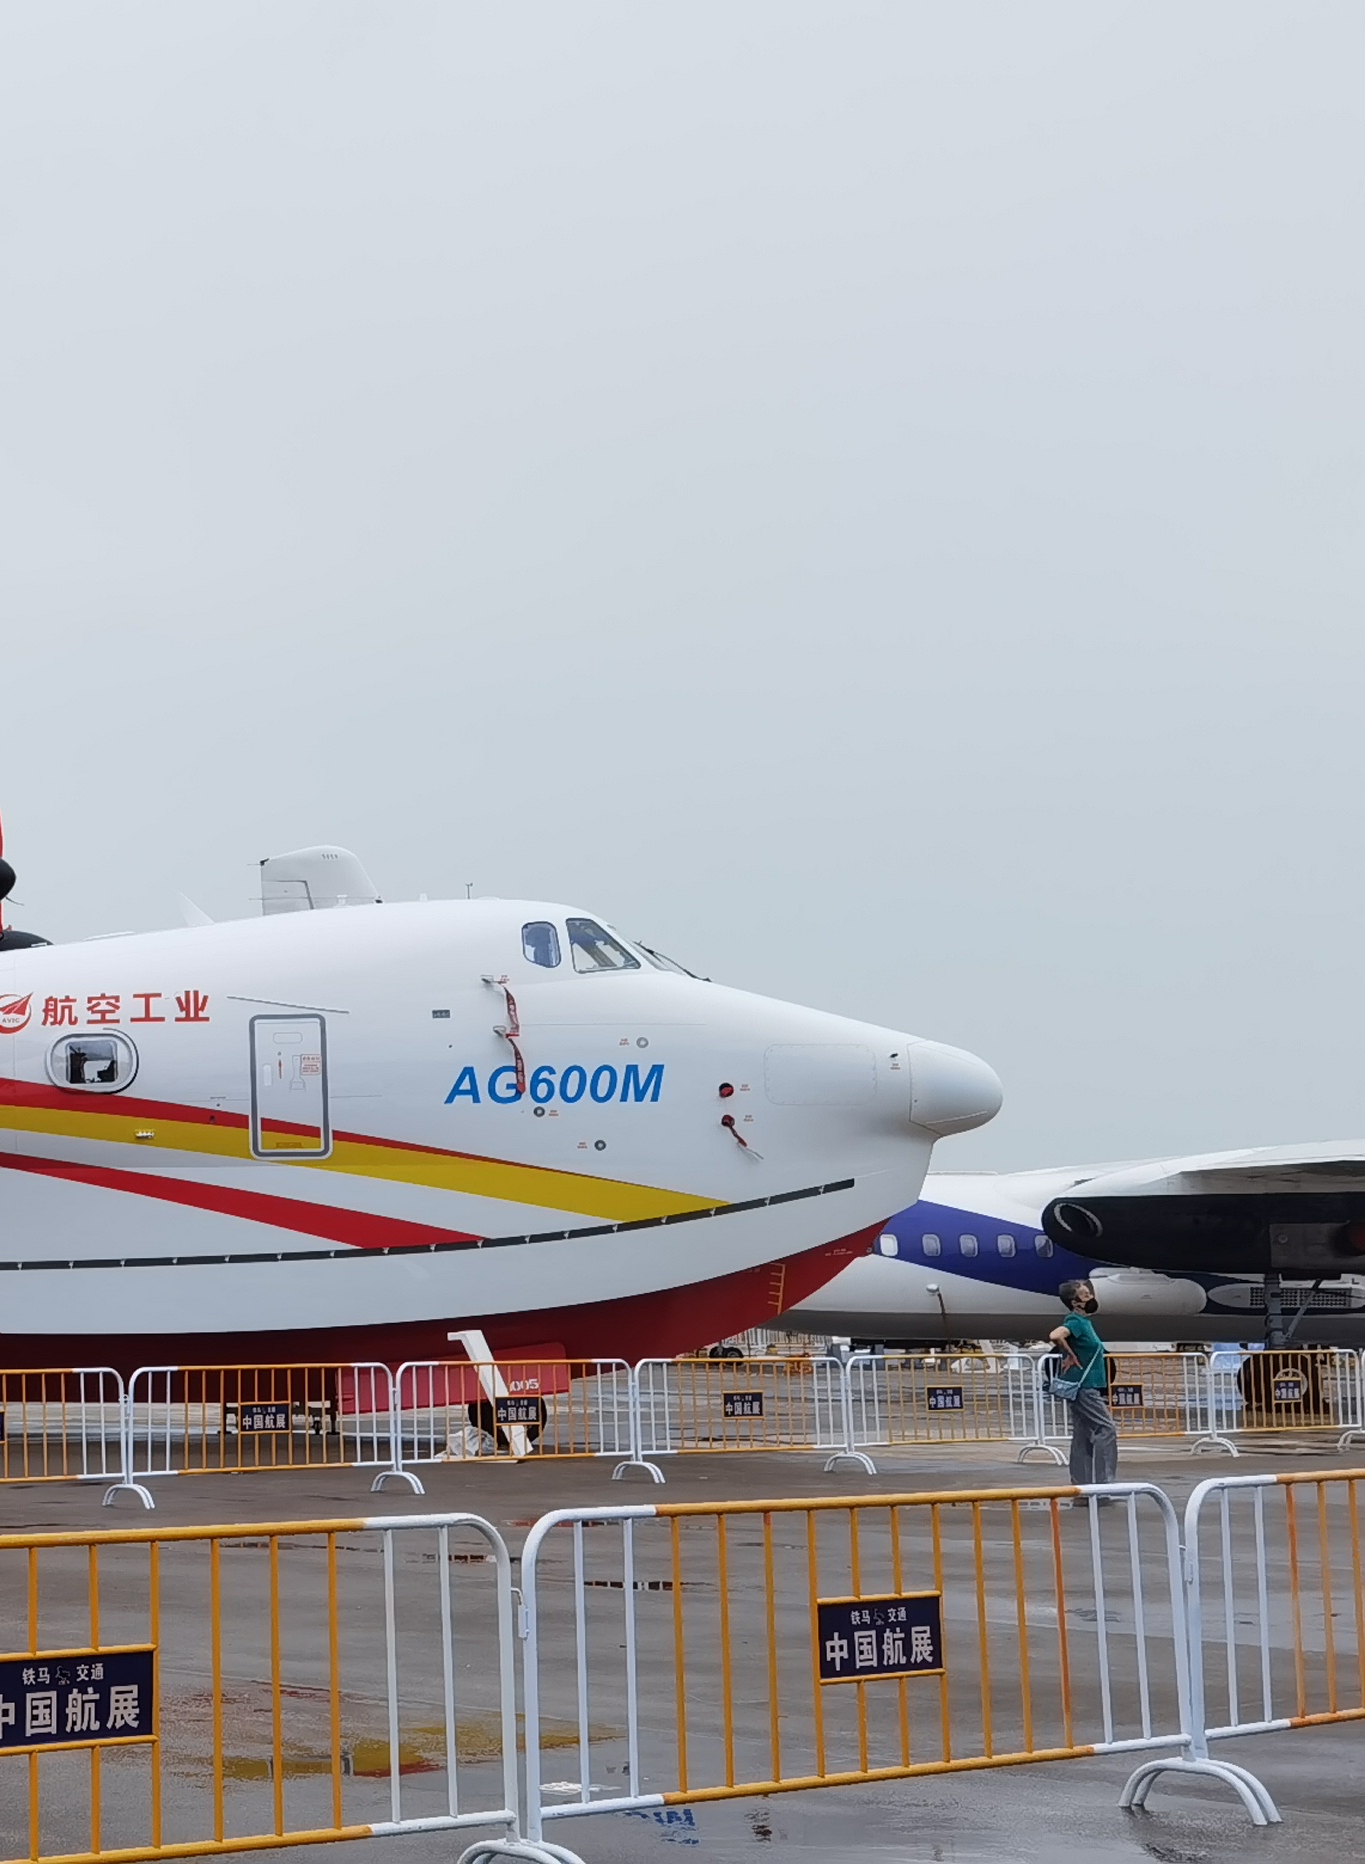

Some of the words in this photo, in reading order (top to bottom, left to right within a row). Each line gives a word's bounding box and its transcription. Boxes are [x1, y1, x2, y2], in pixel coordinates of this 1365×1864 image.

[41, 990, 210, 1027] 航空工业
[444, 1064, 665, 1105] AG600M
[850, 1609, 871, 1625] 铁马
[887, 1606, 907, 1622] 交通
[825, 1625, 934, 1671] 中国航展
[22, 1667, 50, 1685] 铁马
[76, 1663, 104, 1682] 交通
